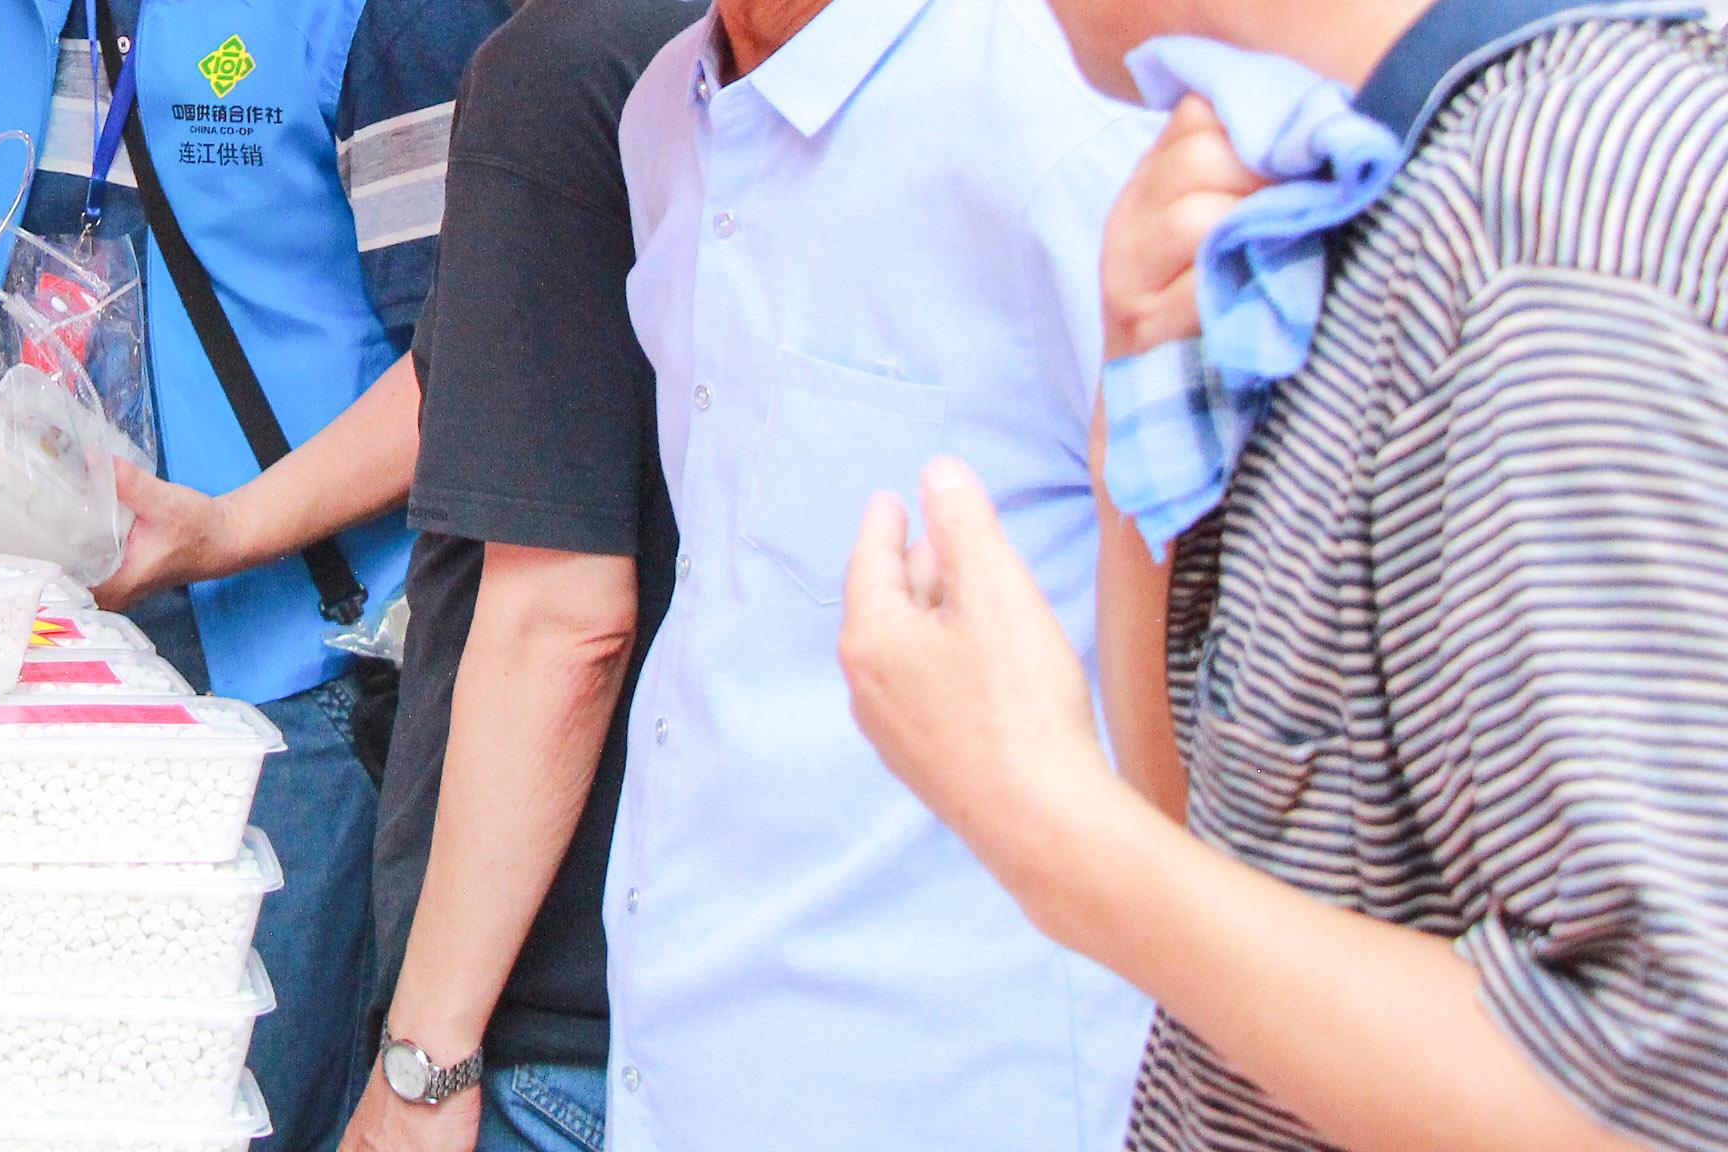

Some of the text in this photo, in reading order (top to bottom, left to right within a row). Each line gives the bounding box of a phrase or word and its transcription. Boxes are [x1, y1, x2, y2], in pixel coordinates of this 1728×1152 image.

[172, 104, 283, 124] 中国供销合作社
[190, 125, 254, 136] CHINA CO-OP
[179, 141, 264, 167] 连江供销
